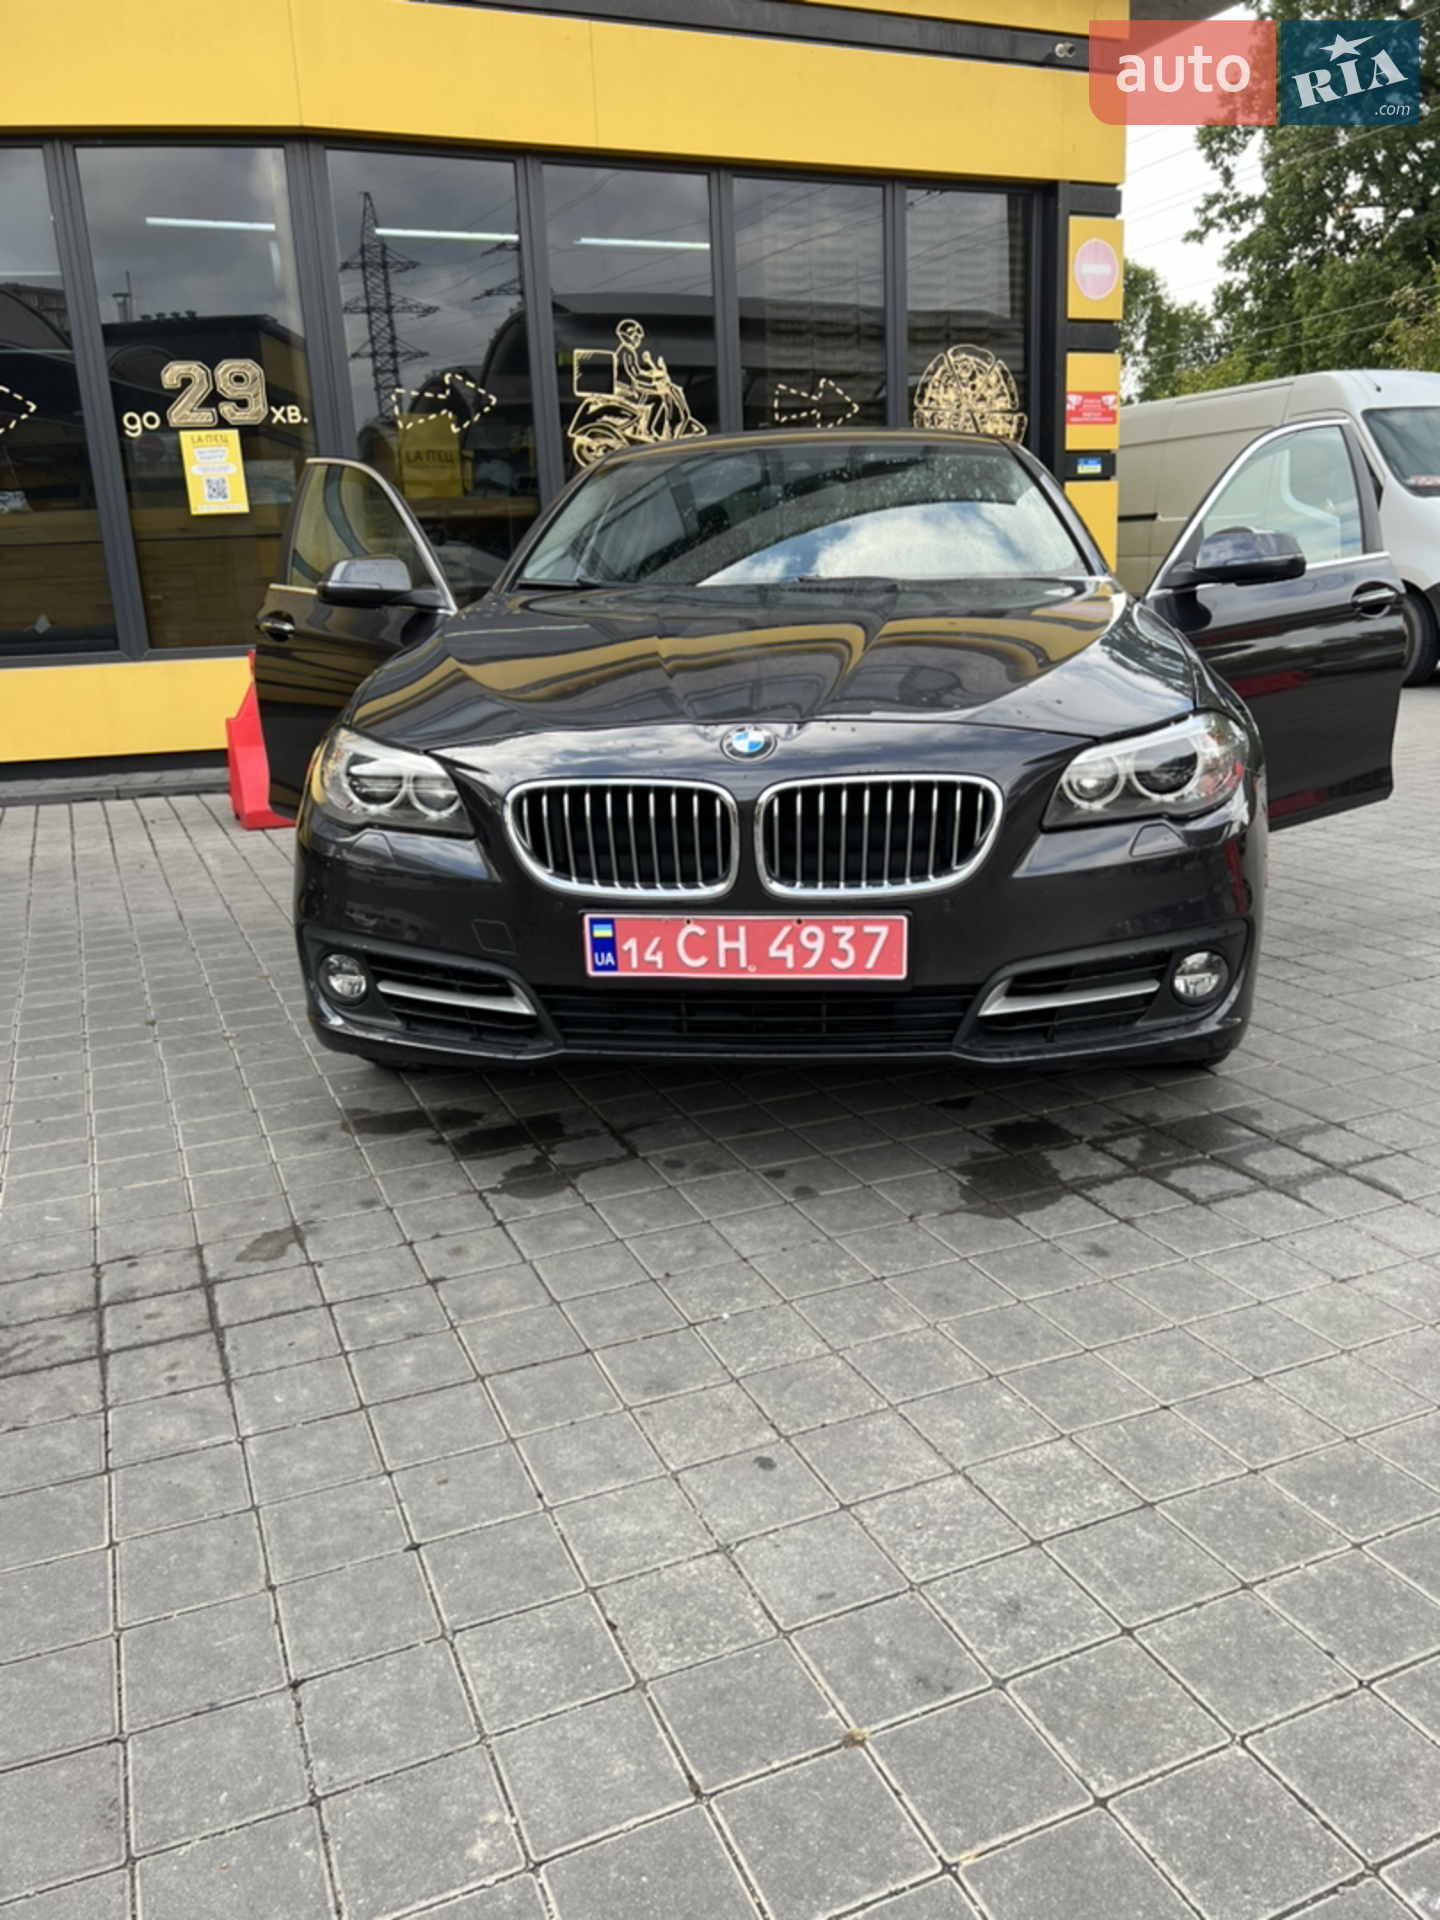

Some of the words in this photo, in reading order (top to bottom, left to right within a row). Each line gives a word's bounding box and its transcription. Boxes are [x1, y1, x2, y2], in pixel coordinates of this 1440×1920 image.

[160, 358, 269, 428] 29
[593, 951, 616, 967] UA
[621, 936, 664, 970] 14
[768, 924, 890, 970] 4937
